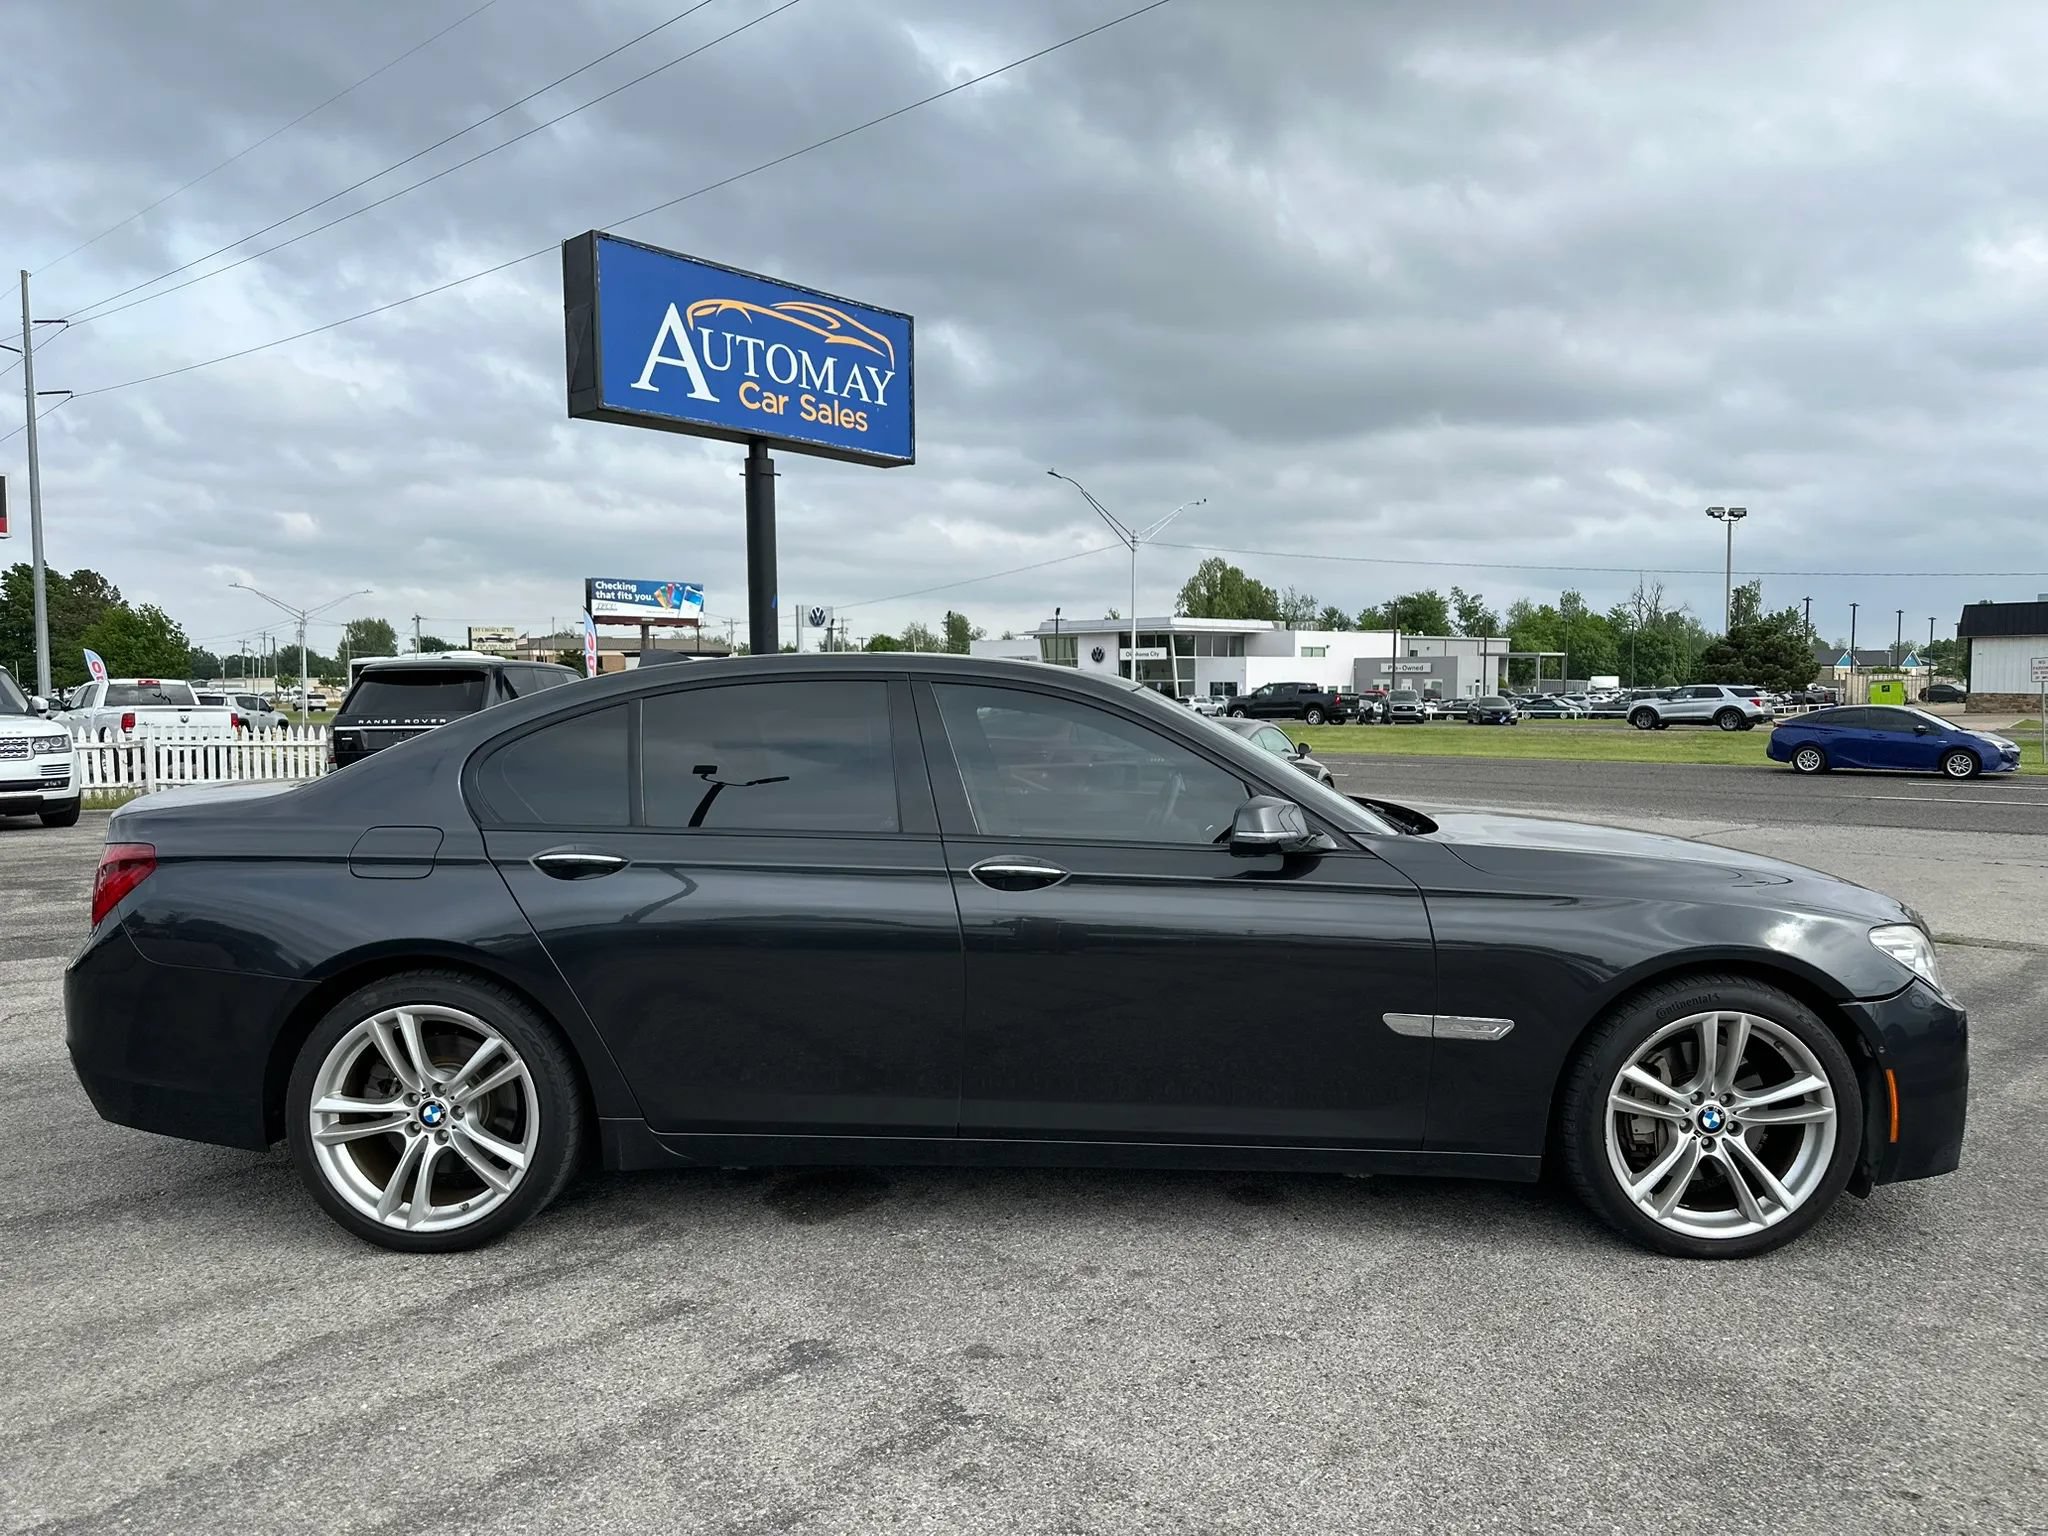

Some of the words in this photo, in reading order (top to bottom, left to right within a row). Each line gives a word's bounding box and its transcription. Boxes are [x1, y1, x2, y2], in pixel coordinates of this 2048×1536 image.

[738, 381, 789, 416] Car
[799, 394, 869, 433] Sales
[595, 581, 637, 592] Checking
[595, 590, 615, 599] that
[617, 592, 633, 600] fits
[635, 593, 655, 602] you.
[1150, 650, 1160, 658] City
